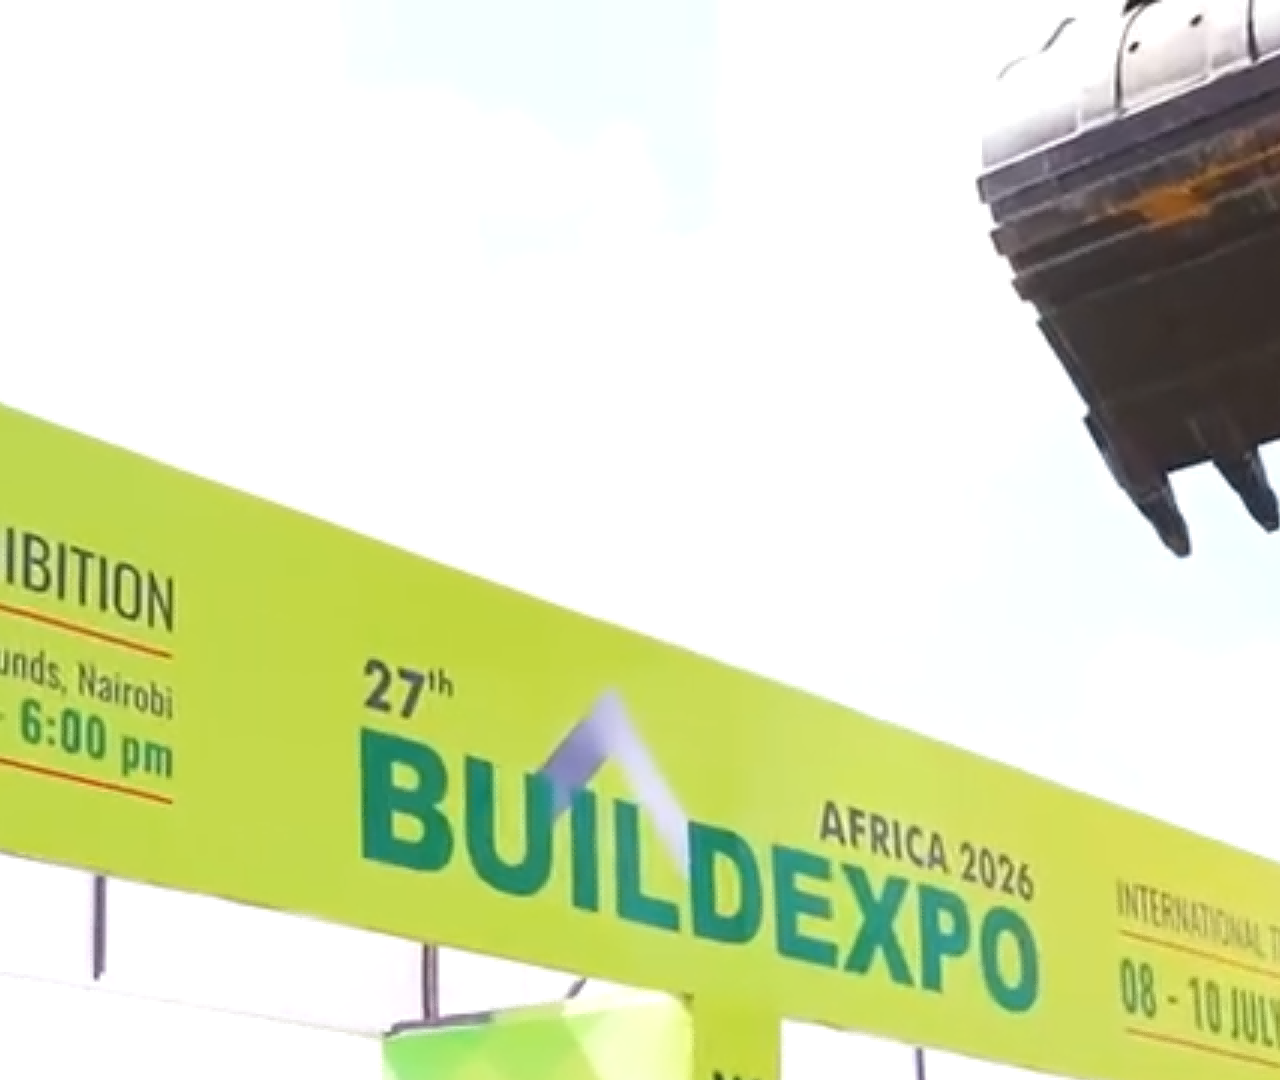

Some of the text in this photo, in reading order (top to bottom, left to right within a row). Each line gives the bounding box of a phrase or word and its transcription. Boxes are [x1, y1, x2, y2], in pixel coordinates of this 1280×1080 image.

[78, 662, 174, 721] Nairobi
[363, 657, 455, 720] 27th
[20, 698, 106, 761] 6:00
[121, 734, 174, 780] pm
[359, 726, 1040, 1014] BUILDEXPO
[819, 799, 1035, 901] AFRICA 2026
[1116, 877, 1267, 958] INTERNATIONAL
[1120, 956, 1158, 1019] 08
[1187, 975, 1222, 1034] 10
